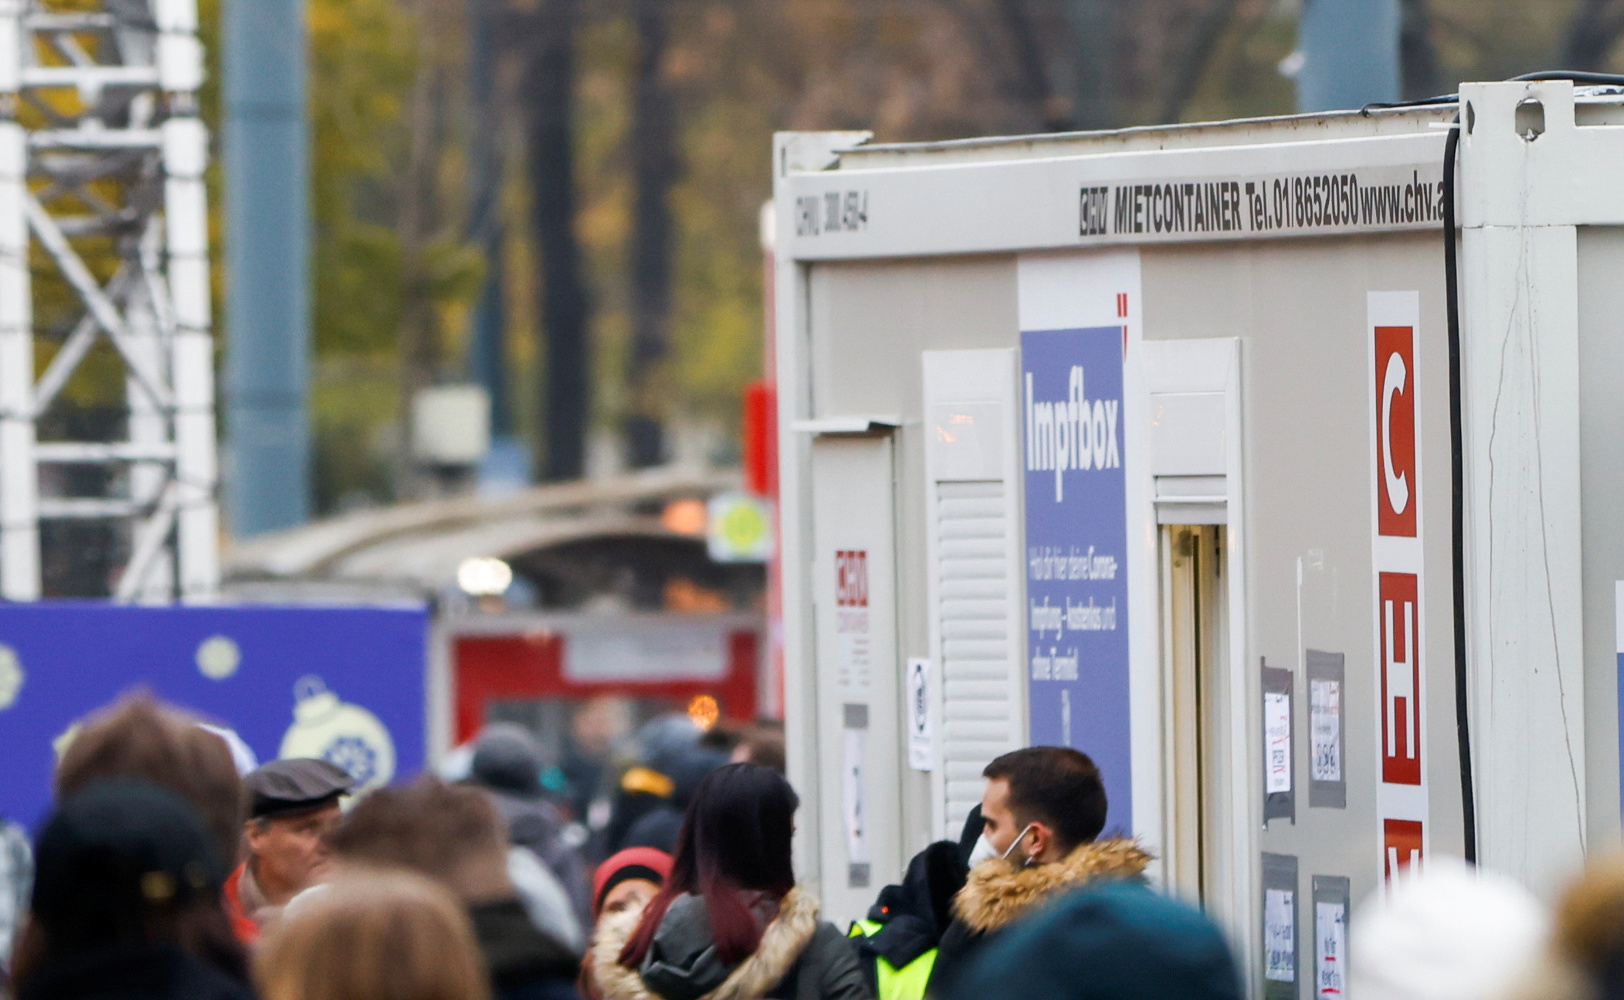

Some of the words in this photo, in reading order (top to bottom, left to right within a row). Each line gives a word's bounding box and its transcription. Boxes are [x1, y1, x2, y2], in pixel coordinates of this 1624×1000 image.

[1114, 181, 1242, 234] MIETCONTAINER
[1359, 169, 1445, 225] www.chv.a
[1026, 365, 1120, 503] Impfbox
